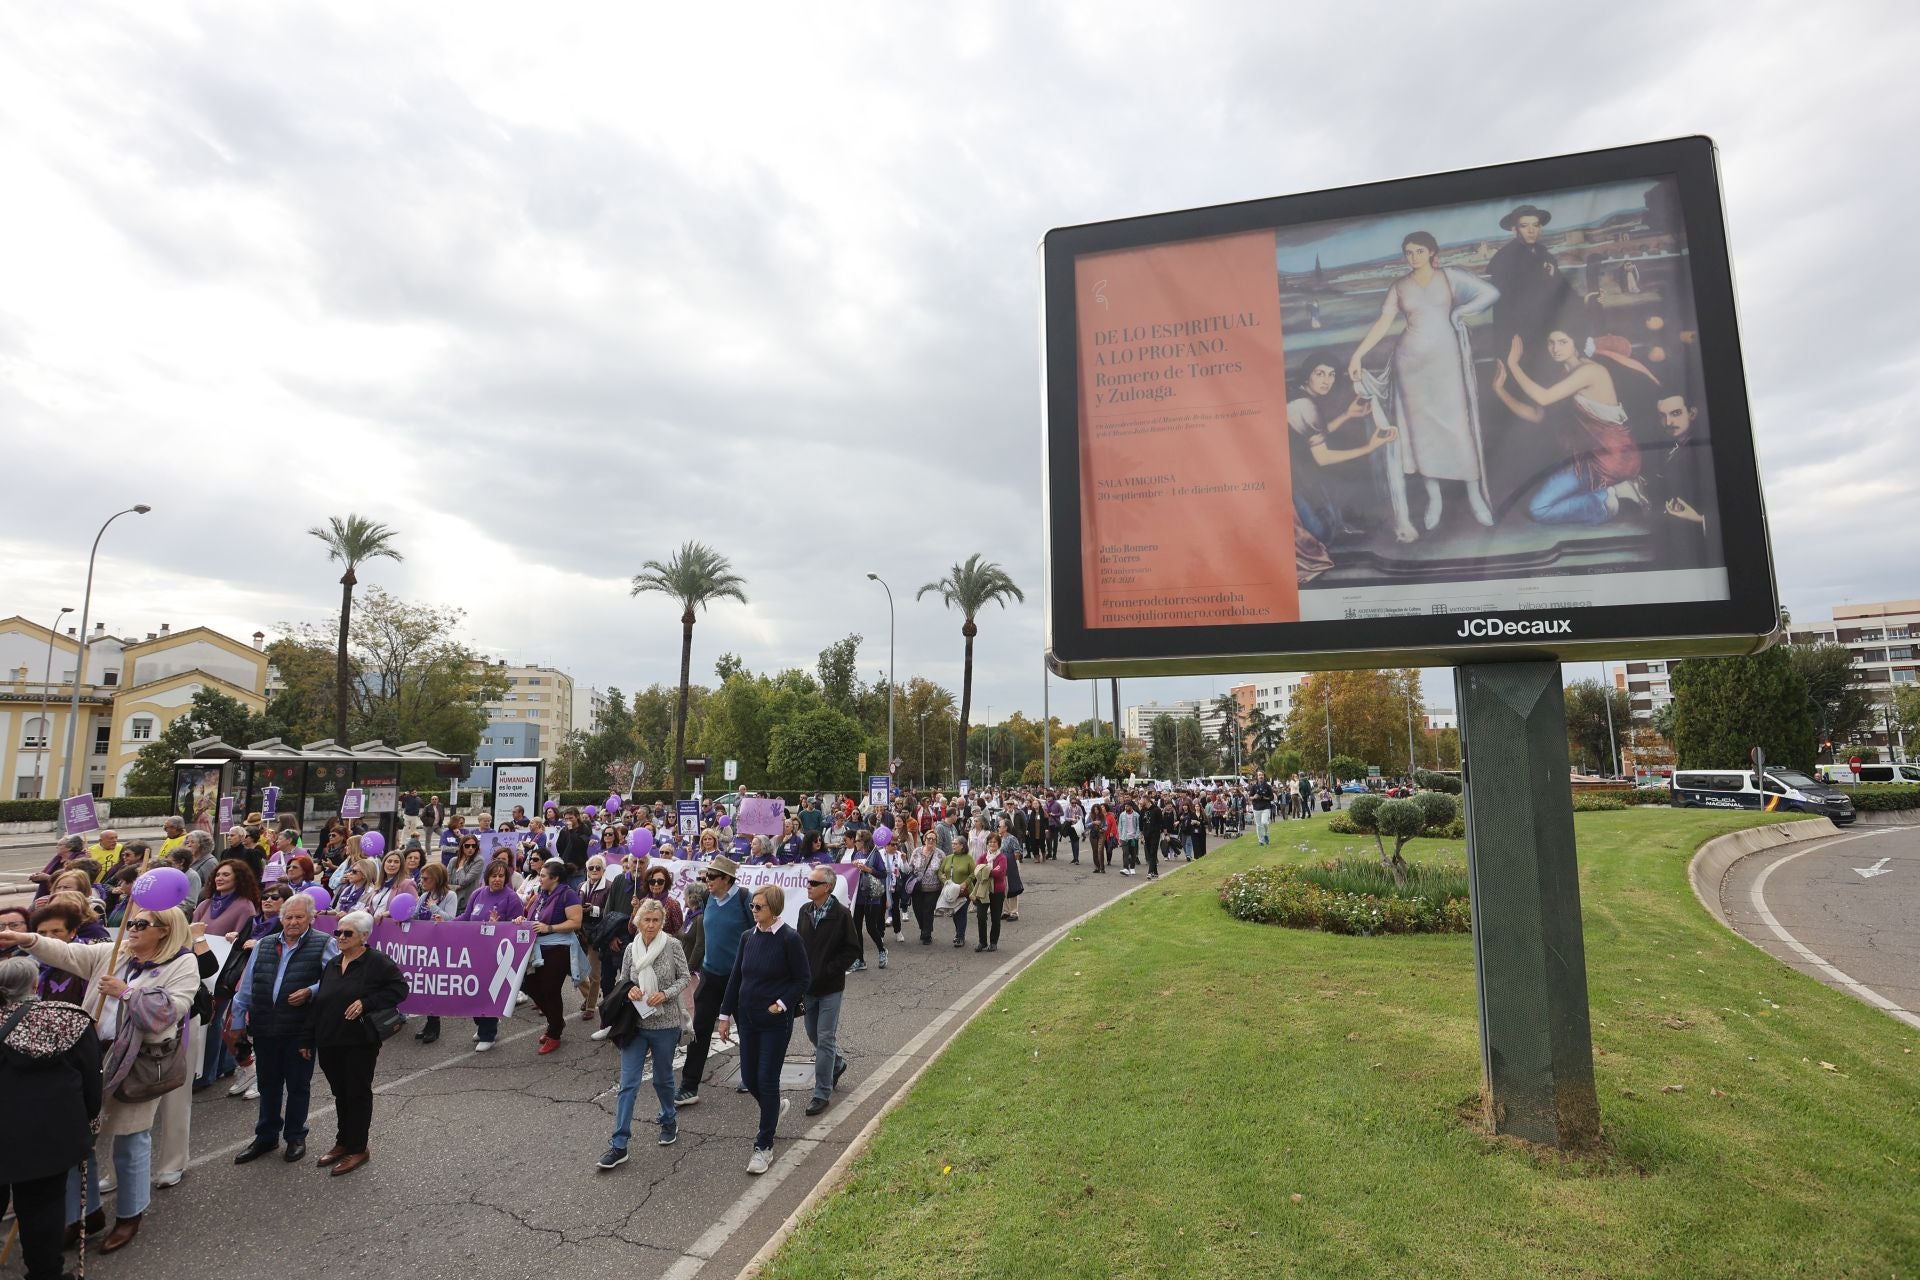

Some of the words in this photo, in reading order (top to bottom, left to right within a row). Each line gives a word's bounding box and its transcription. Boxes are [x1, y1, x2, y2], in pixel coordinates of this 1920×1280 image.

[1095, 329, 1118, 346] DE
[1123, 326, 1146, 343] LO
[1151, 313, 1260, 339] ESPIRITUAL
[1095, 351, 1105, 366] A
[1111, 349, 1133, 365] LO
[1138, 338, 1229, 361] PROFANO.
[1095, 369, 1160, 387] Romero
[1163, 365, 1184, 380] de
[1187, 360, 1243, 378] Torres
[1095, 392, 1104, 408] y
[1108, 385, 1177, 404] Zuloaga.
[1098, 479, 1122, 488] SALA
[1124, 474, 1176, 487] VIMCORSA
[1112, 488, 1163, 502] septiembre
[1178, 486, 1189, 496] de
[1191, 483, 1240, 495] diciembre
[1242, 481, 1265, 491] 2024
[1100, 544, 1122, 554] Julio
[1124, 544, 1159, 552] Romero
[1100, 555, 1111, 564] de
[1112, 554, 1140, 563] Torres
[1102, 592, 1244, 609] #romerodetorrescordoba
[1102, 605, 1270, 623] museojulioromero.cordoba.es
[1457, 618, 1572, 638] JCDecaux
[735, 871, 752, 886] sta
[755, 870, 770, 886] de
[774, 870, 809, 888] Monto
[386, 941, 440, 968] CONTRA
[446, 946, 472, 969] LA
[402, 965, 480, 997] GÉNERO
